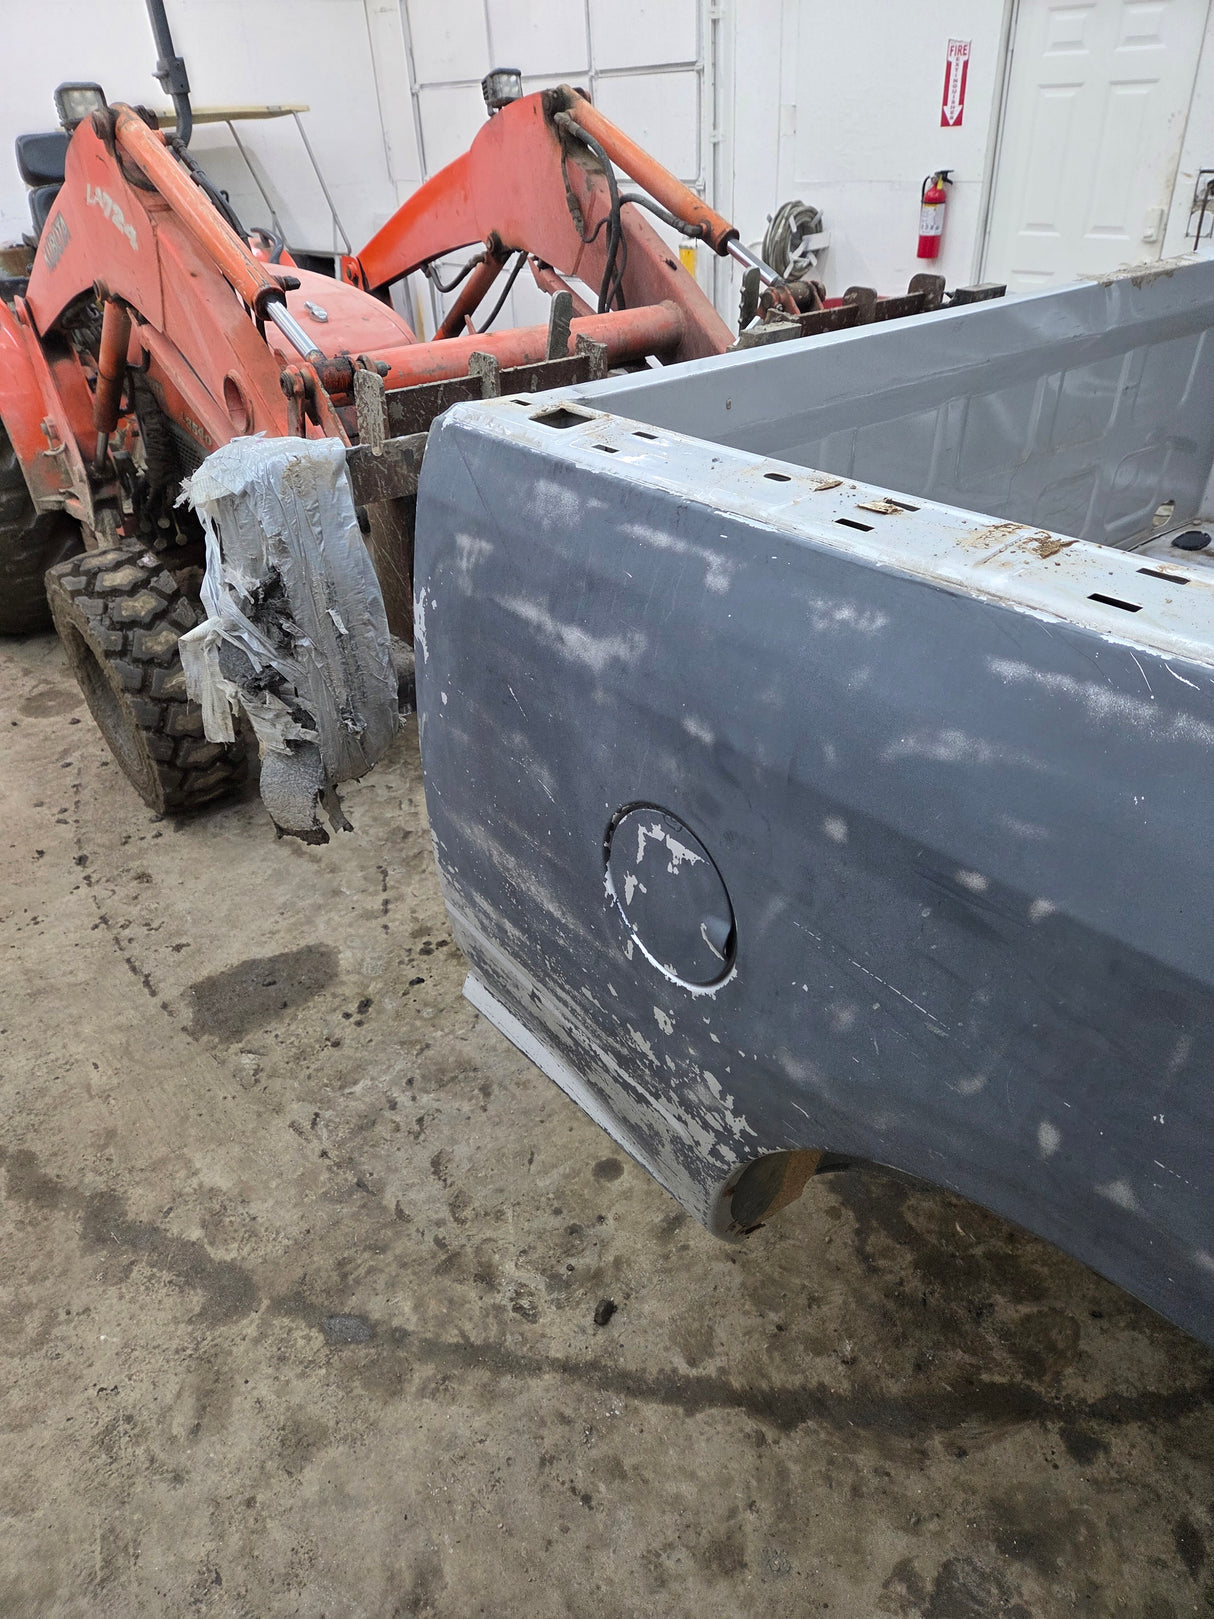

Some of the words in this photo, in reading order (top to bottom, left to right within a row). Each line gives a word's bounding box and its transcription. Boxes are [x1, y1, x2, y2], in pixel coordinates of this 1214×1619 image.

[949, 44, 969, 57] FIRE
[949, 56, 960, 120] EXTINGUISHER
[86, 183, 139, 252] LA724
